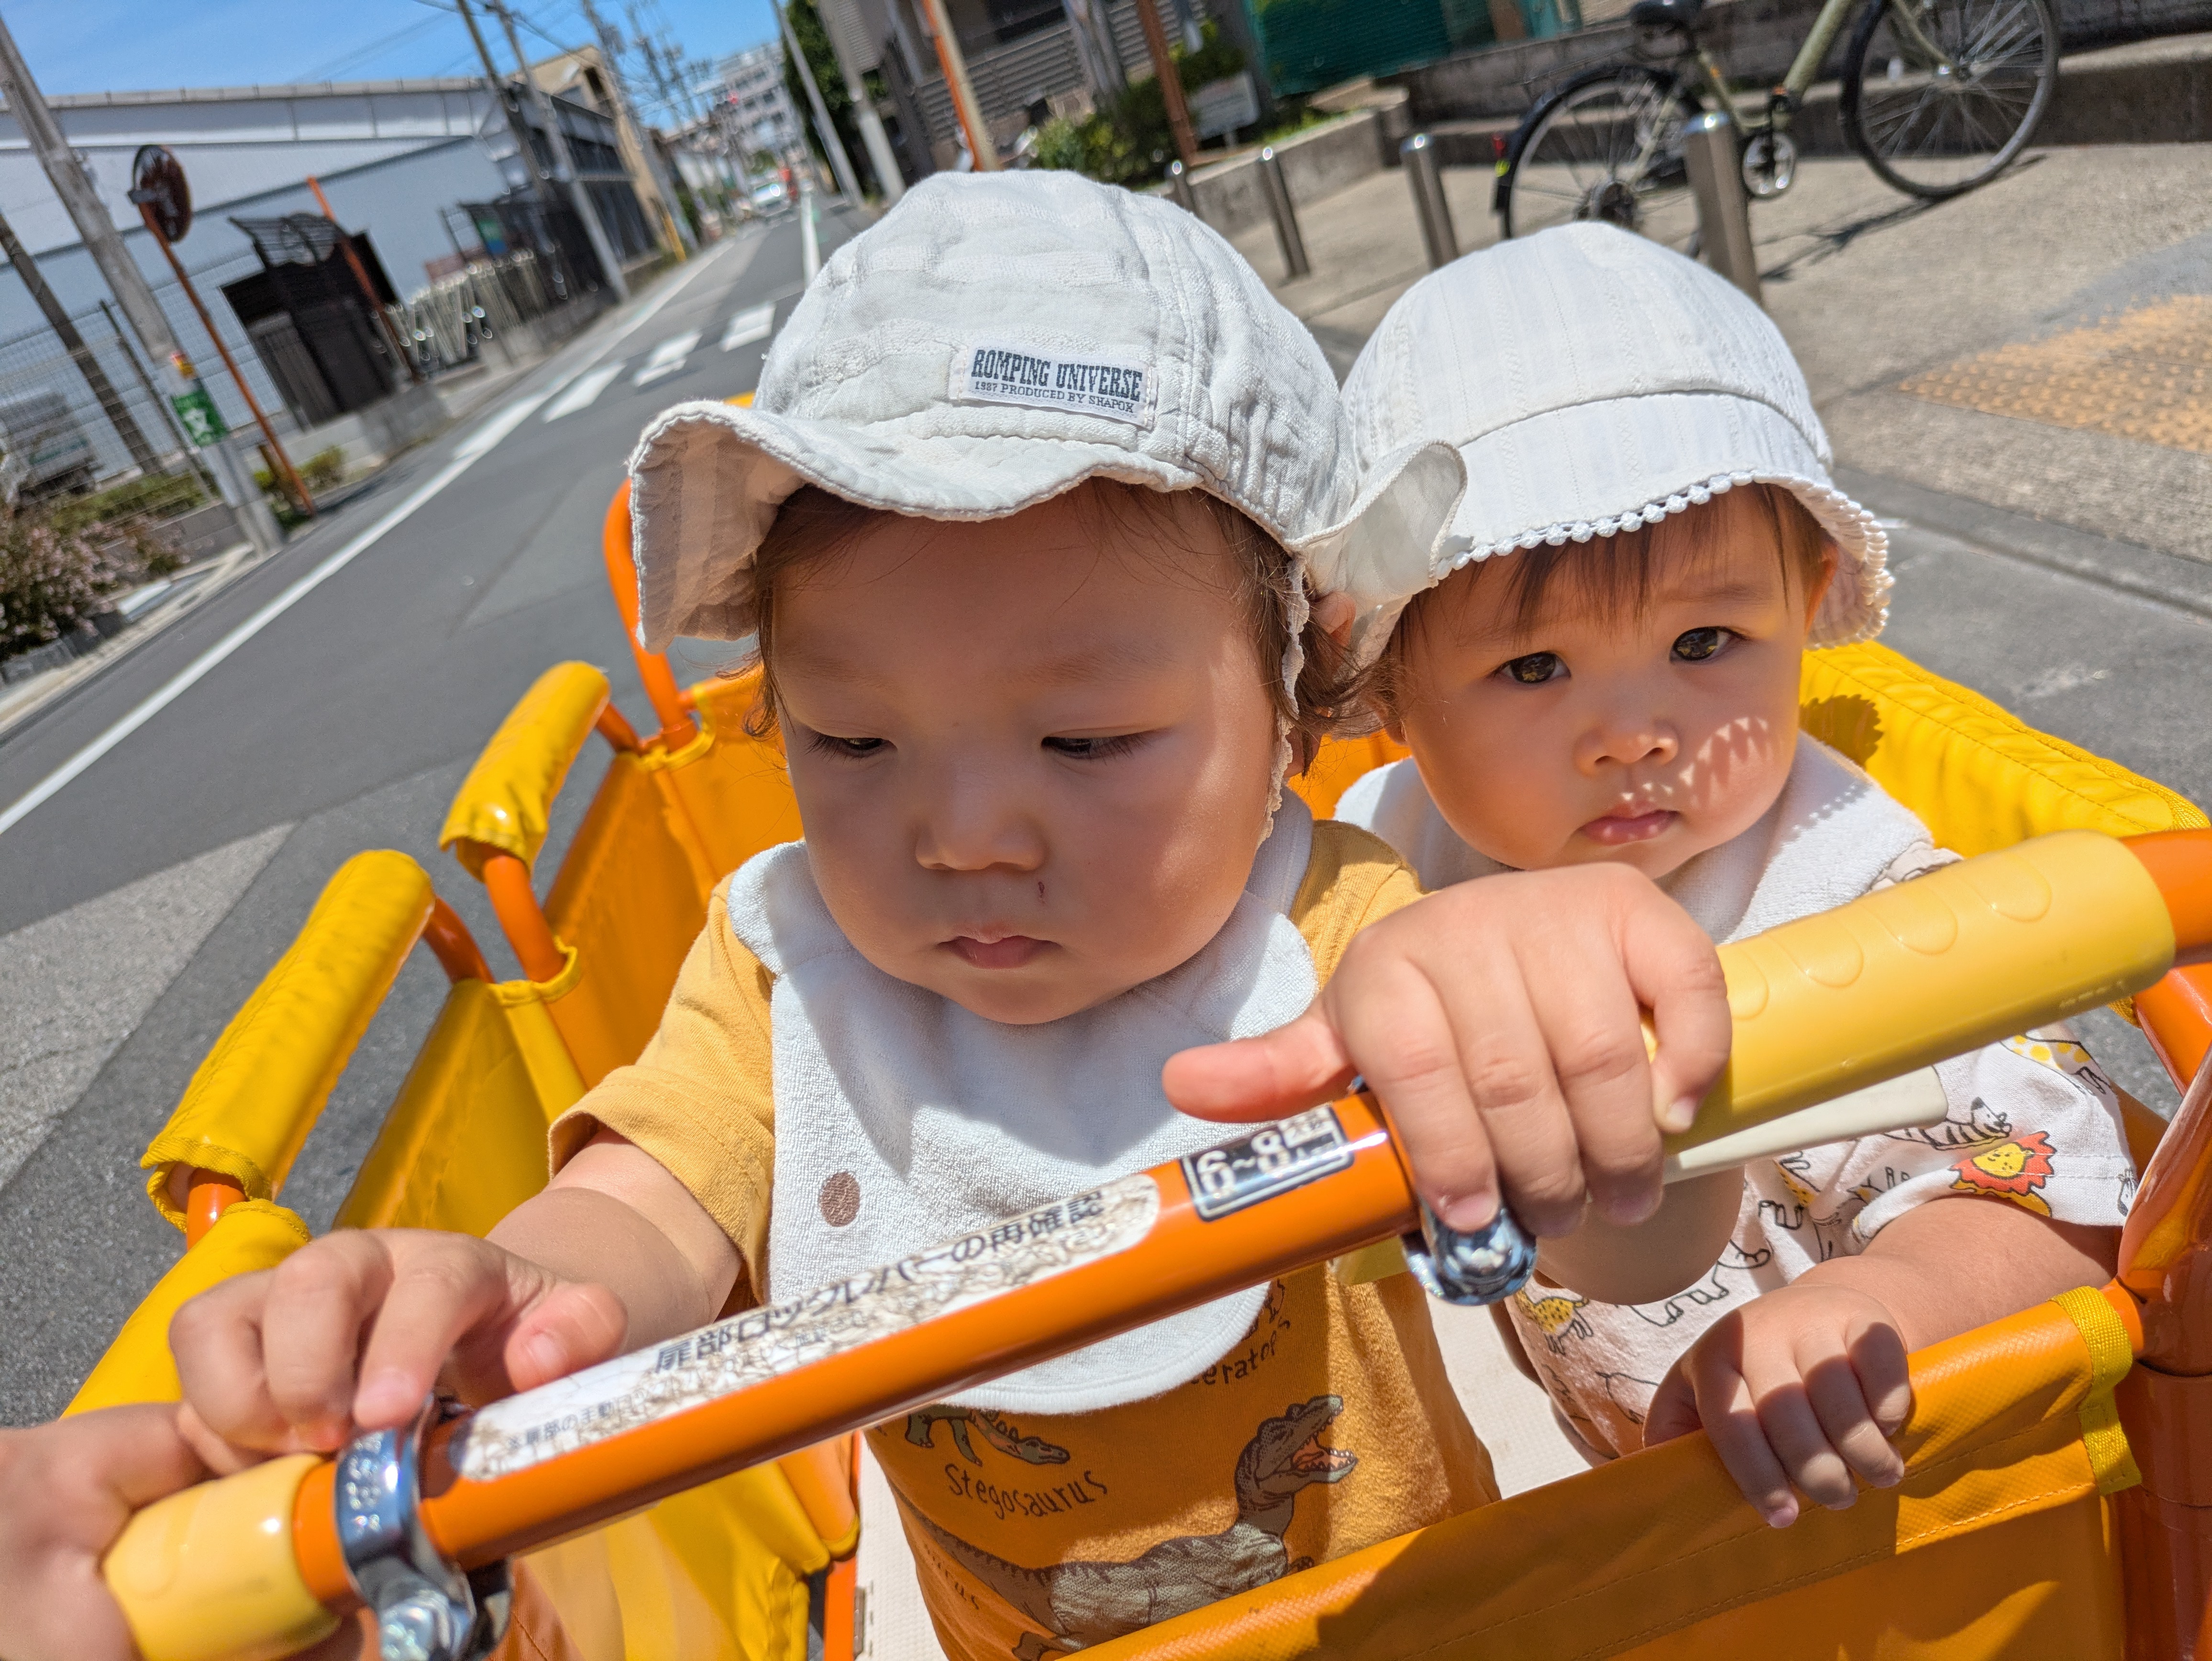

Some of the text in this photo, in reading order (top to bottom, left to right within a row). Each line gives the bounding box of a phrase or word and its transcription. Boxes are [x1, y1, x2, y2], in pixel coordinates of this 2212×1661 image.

[971, 350, 1143, 402] ROMPING UNIVERSE
[1000, 383, 1065, 400] PRODUCED
[1068, 392, 1086, 403] BY
[1190, 1316, 1291, 1385] eratops
[944, 1463, 1108, 1520] Stegosaurus
